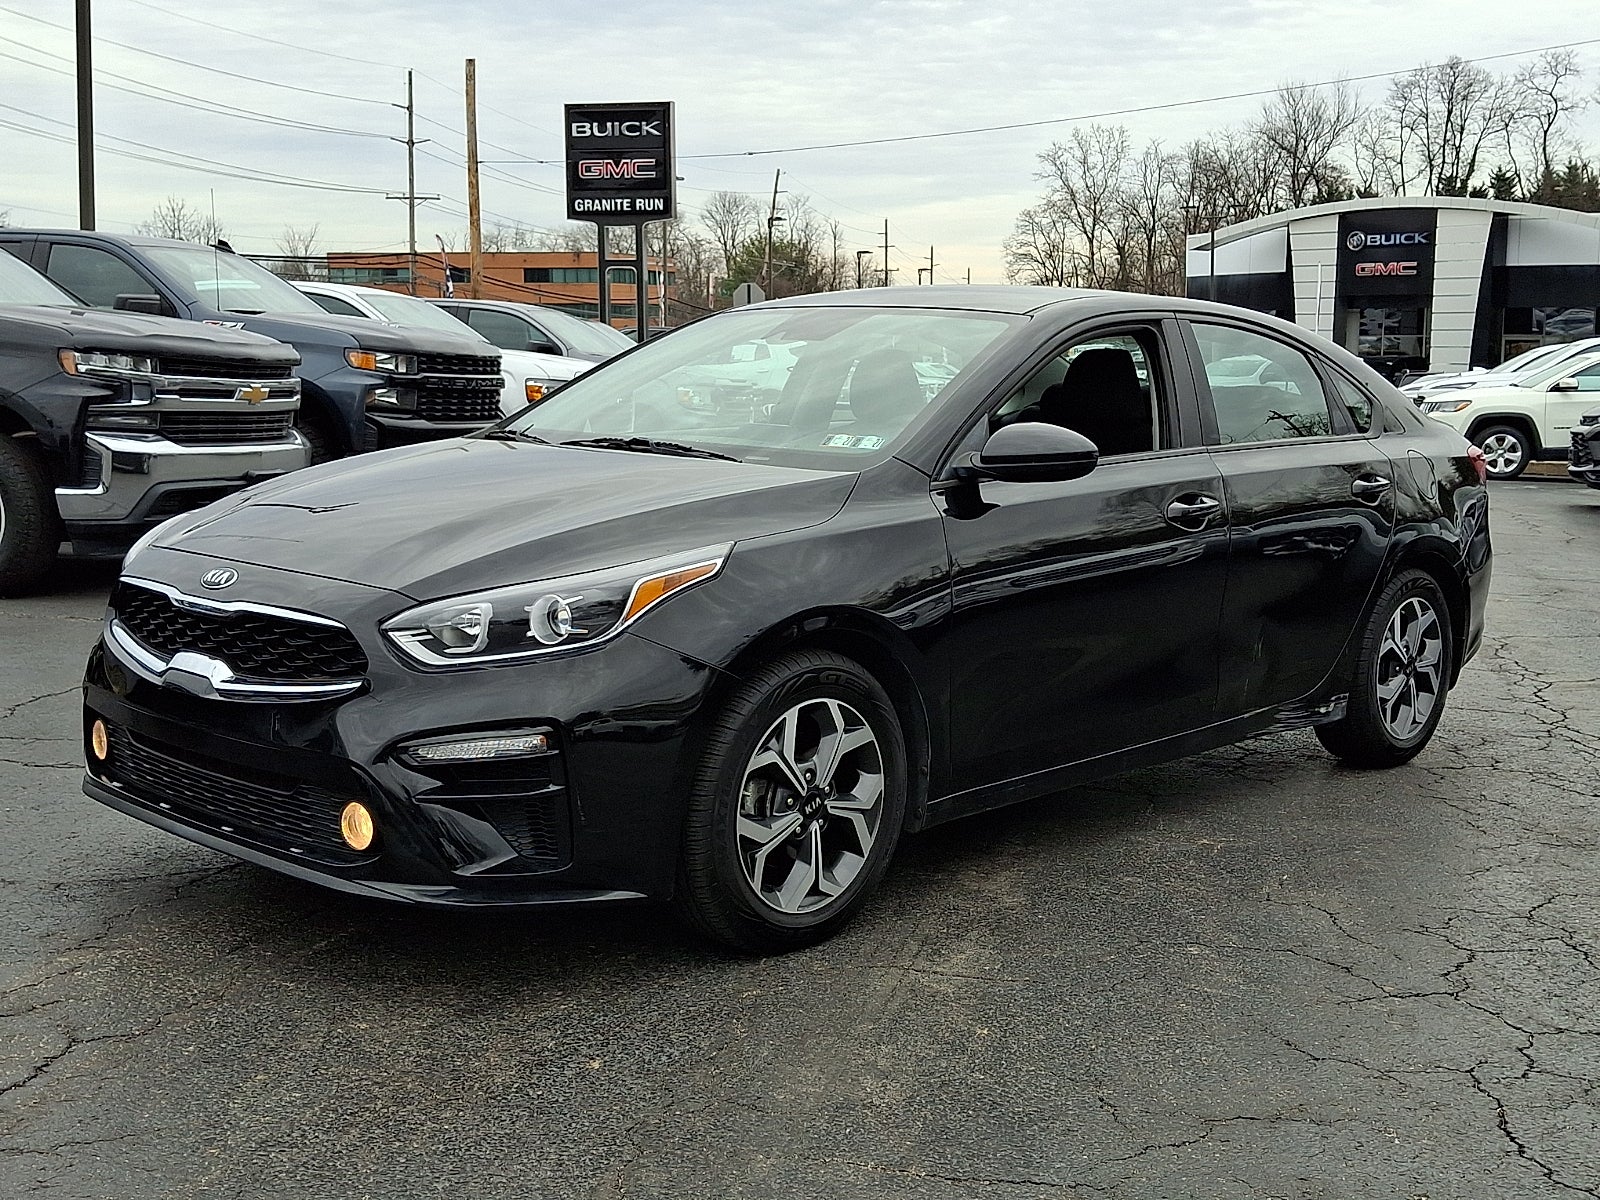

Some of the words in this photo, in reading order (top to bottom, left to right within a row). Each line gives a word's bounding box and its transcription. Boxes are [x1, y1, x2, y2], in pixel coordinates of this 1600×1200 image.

[571, 121, 662, 137] BUICK
[579, 159, 656, 179] GMC
[574, 198, 631, 212] GRANITE
[636, 198, 664, 211] RUN
[1366, 232, 1430, 246] BUICK
[1355, 261, 1418, 276] GMC
[203, 569, 231, 585] KIA
[805, 797, 822, 815] KIA
